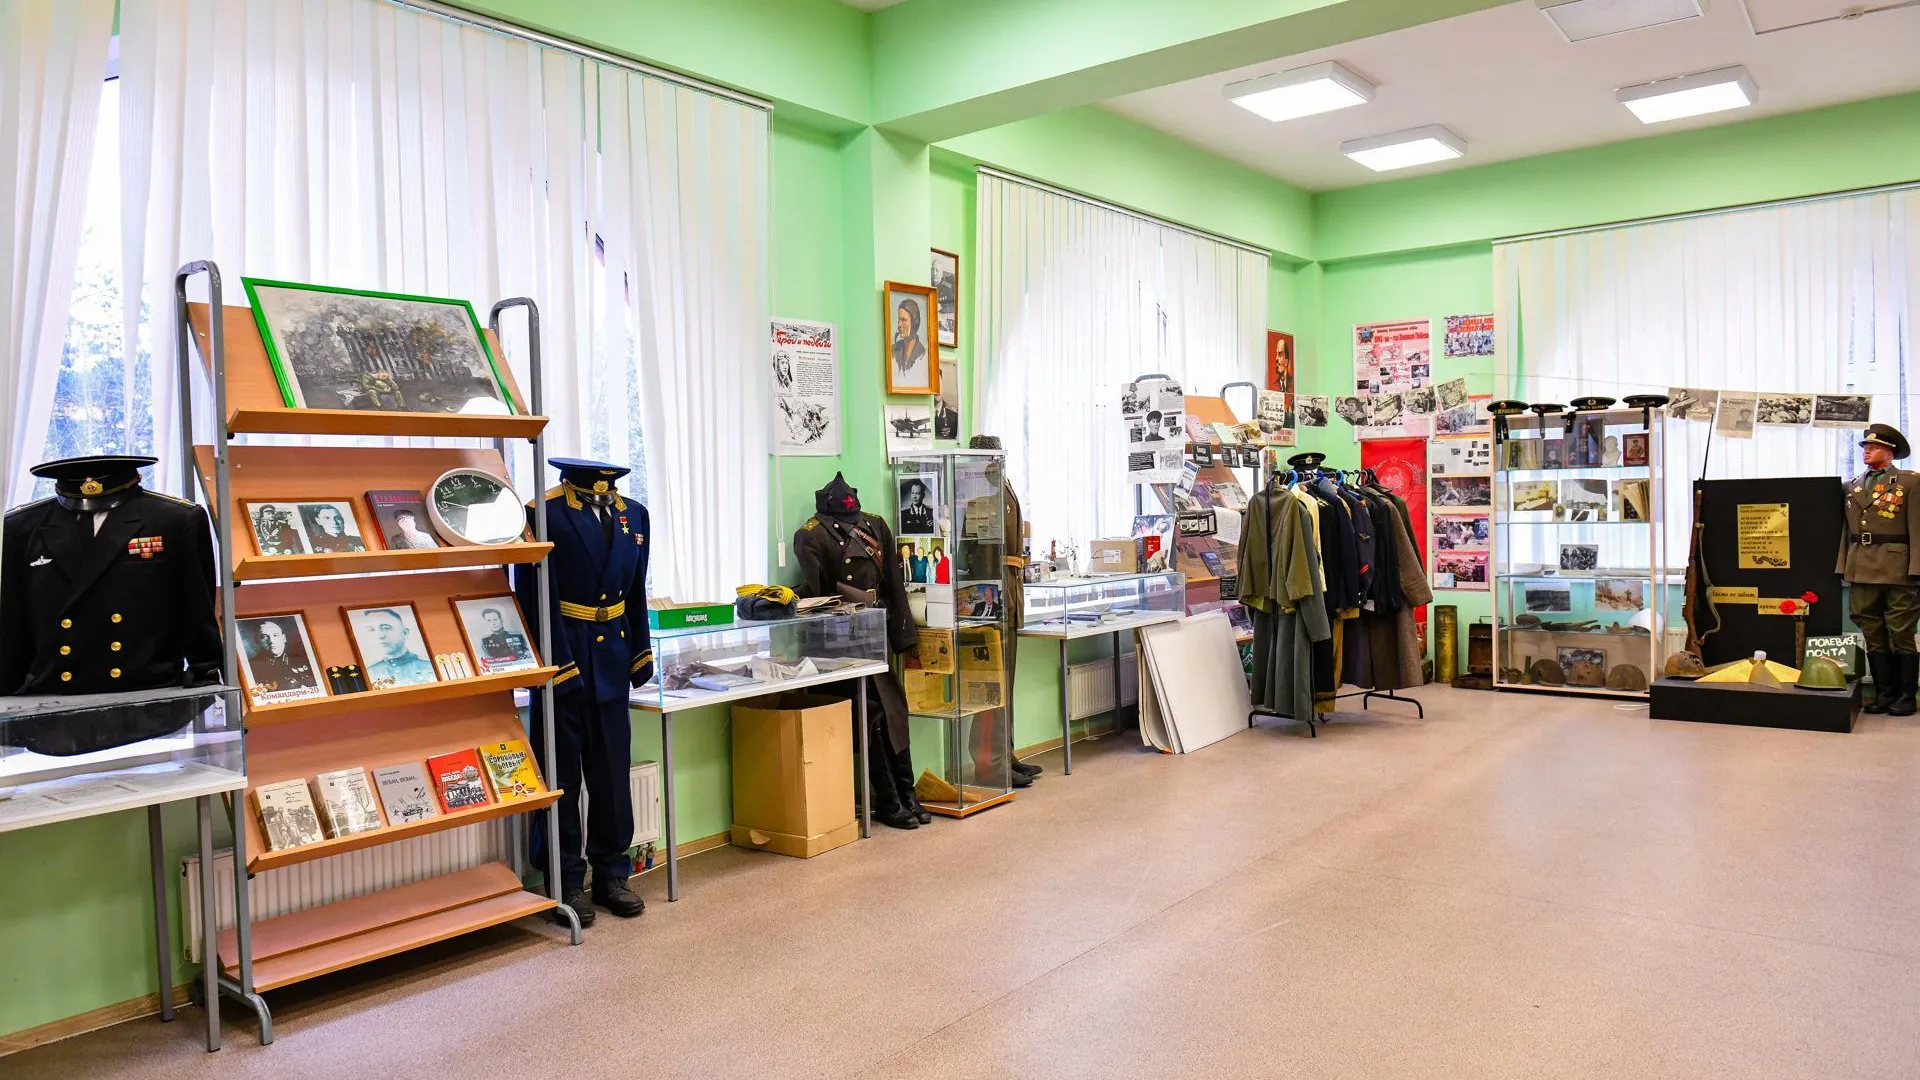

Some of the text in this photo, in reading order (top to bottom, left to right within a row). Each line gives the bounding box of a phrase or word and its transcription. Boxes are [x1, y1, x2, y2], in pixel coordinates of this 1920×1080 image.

[776, 330, 797, 347] Герои
[803, 336, 832, 348] подвиги
[451, 478, 462, 487] 12
[440, 486, 452, 496] 11
[437, 501, 448, 510] 10
[1808, 635, 1857, 647] ПОЛЕВАЯ
[1806, 646, 1847, 657] ПОЧТА
[260, 686, 320, 700] Командарм-20
[489, 751, 526, 764] СОРОКОВЫЕ
[498, 760, 521, 770] БОЕВЫЕ
